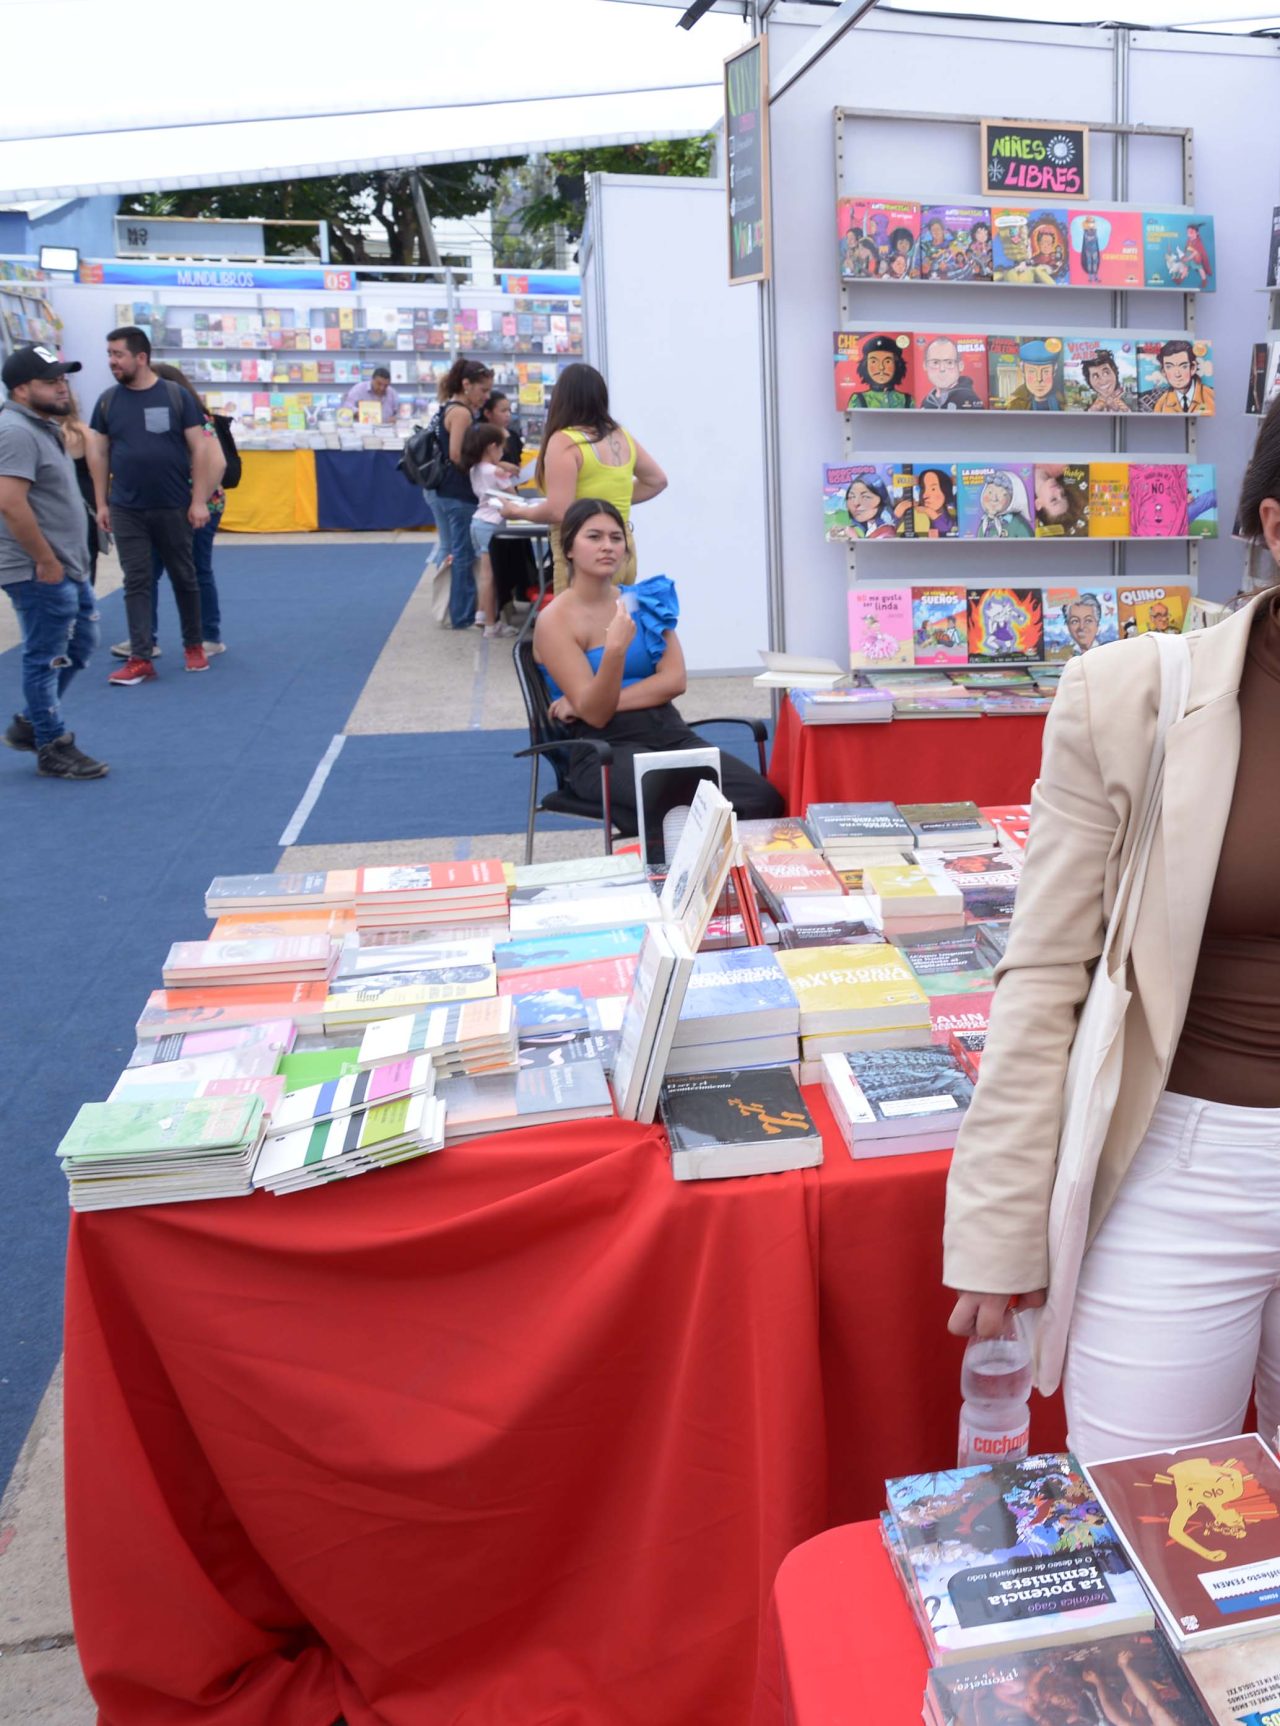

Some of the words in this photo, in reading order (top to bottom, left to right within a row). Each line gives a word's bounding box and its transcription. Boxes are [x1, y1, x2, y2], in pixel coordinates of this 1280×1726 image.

[991, 134, 1046, 160] NIÑES
[1004, 162, 1081, 192] LIBRES
[177, 270, 254, 288] MUNDILIBROS
[326, 271, 350, 289] 05
[838, 333, 859, 349] CHE
[957, 344, 985, 353] BIELSA
[1152, 483, 1164, 494] NO
[921, 594, 959, 605] SUEÑOS
[1120, 588, 1166, 605] QUINO
[875, 601, 899, 612] linda
[1034, 1563, 1046, 1572] de
[1047, 1559, 1073, 1569] deseo
[966, 1574, 987, 1583] todo
[989, 1566, 1033, 1579] cambiarlo
[1000, 1566, 1099, 1591] feminista
[1078, 1578, 1105, 1592] La
[1212, 1578, 1246, 1590] FEMEN
[987, 1581, 1076, 1607] potencia
[1060, 1592, 1109, 1608] Verónica
[1027, 1601, 1057, 1613] Gago
[1238, 1681, 1254, 1691] SIGLO
[1269, 1681, 1280, 1691] QUE
[1227, 1687, 1269, 1704] NECESITAMOS
[1260, 1691, 1276, 1704] SOBRE
